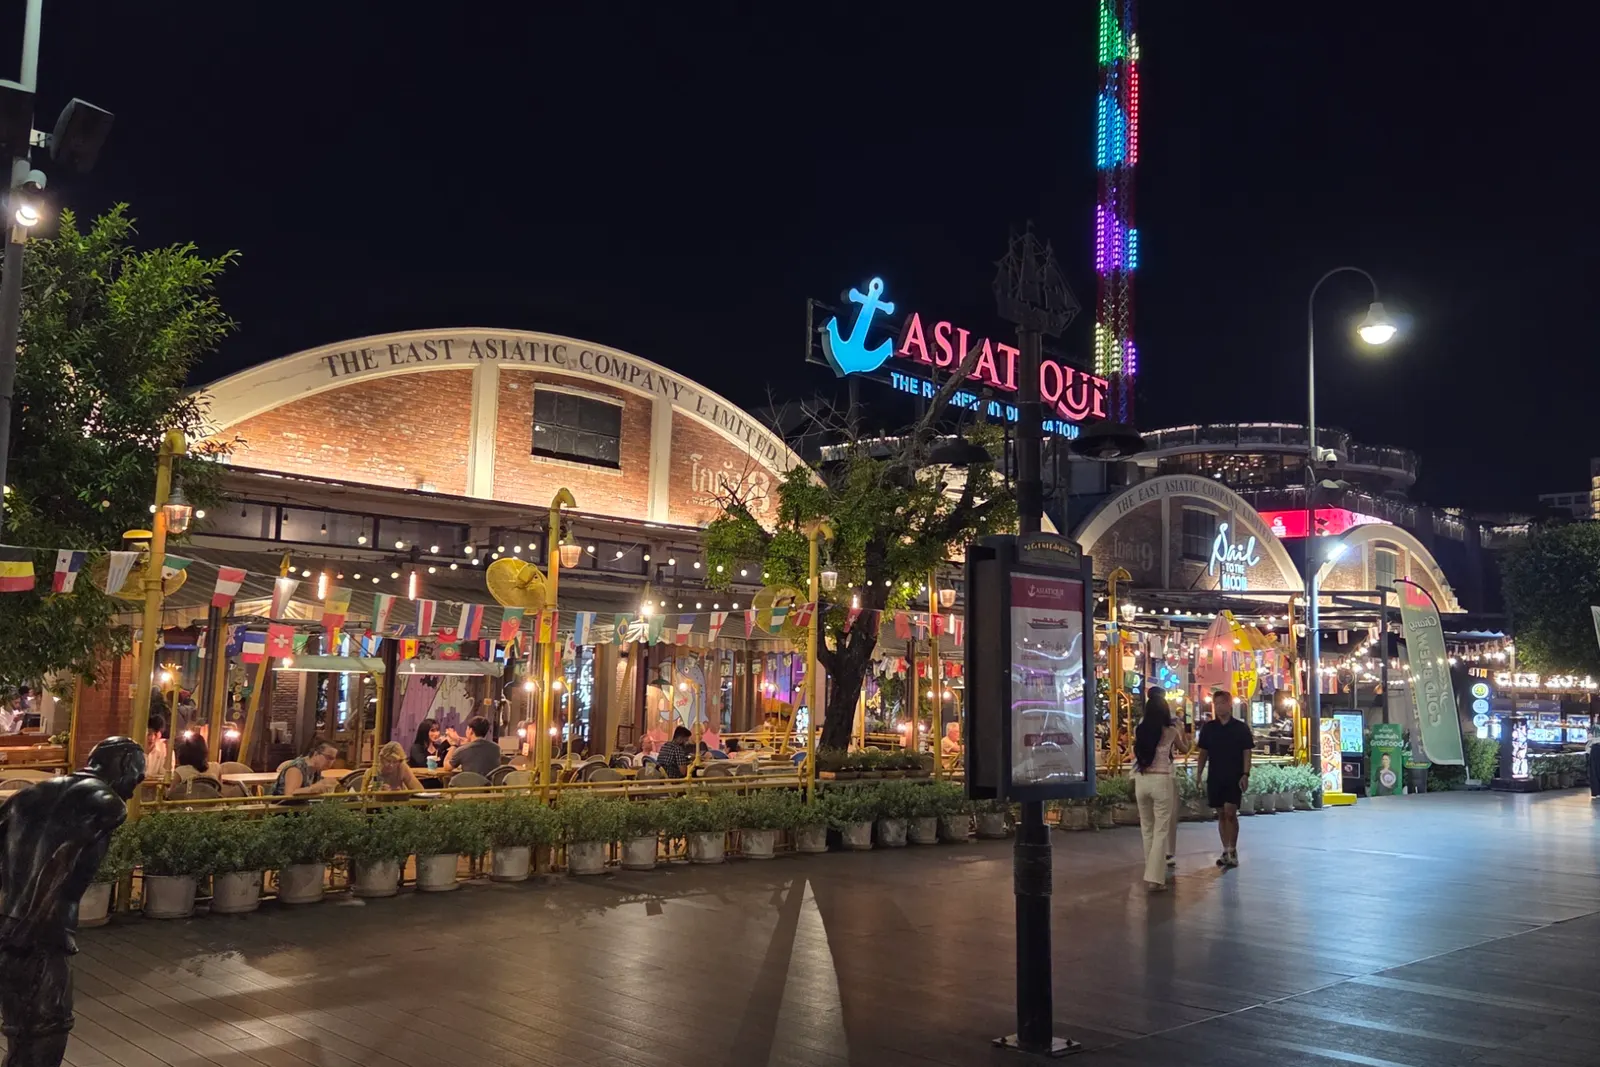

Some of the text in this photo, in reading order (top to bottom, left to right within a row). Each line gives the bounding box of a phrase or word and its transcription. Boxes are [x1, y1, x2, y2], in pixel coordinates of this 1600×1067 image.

[898, 312, 1109, 420] ASIATQUE
[890, 371, 919, 395] THE
[320, 338, 779, 461] THE EAST ASIATIC COMPANY LIMITED
[1116, 494, 1135, 514] THE
[1138, 482, 1161, 500] EAST
[1164, 480, 1199, 493] ASIATIC
[1202, 482, 1239, 510] COMPANY
[1209, 522, 1260, 577] Sail
[1222, 573, 1249, 591] MOON
[1225, 562, 1245, 574] TO THE
[1370, 739, 1404, 747] GrabFood
